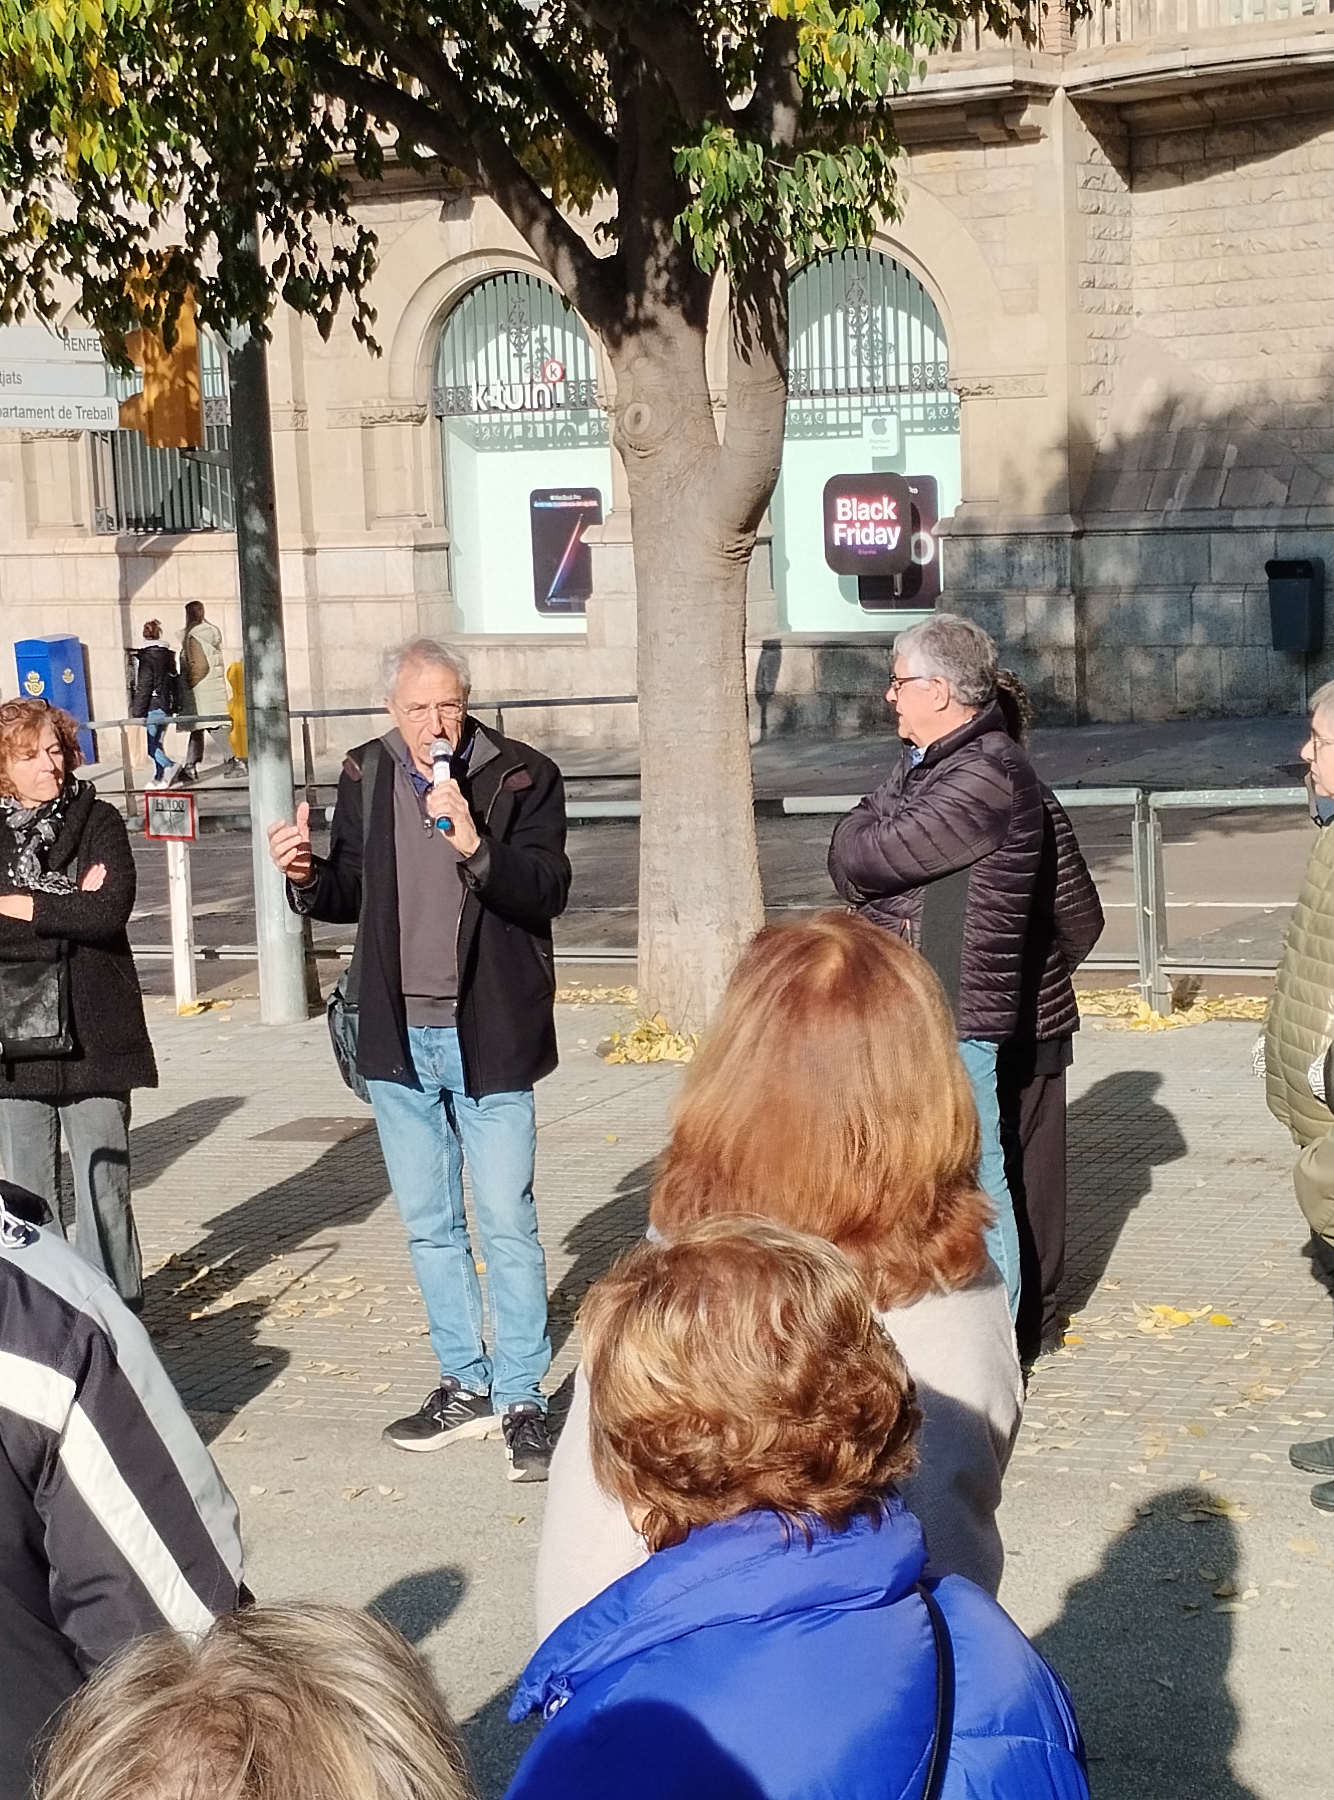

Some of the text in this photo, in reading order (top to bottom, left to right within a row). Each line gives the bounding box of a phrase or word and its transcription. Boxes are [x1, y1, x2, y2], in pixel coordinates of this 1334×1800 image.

[63, 337, 101, 352] RENFE
[472, 378, 551, 412] k-tuin
[58, 405, 72, 419] de
[75, 405, 113, 420] Treball
[837, 496, 898, 521] Black
[834, 521, 902, 551] Friday
